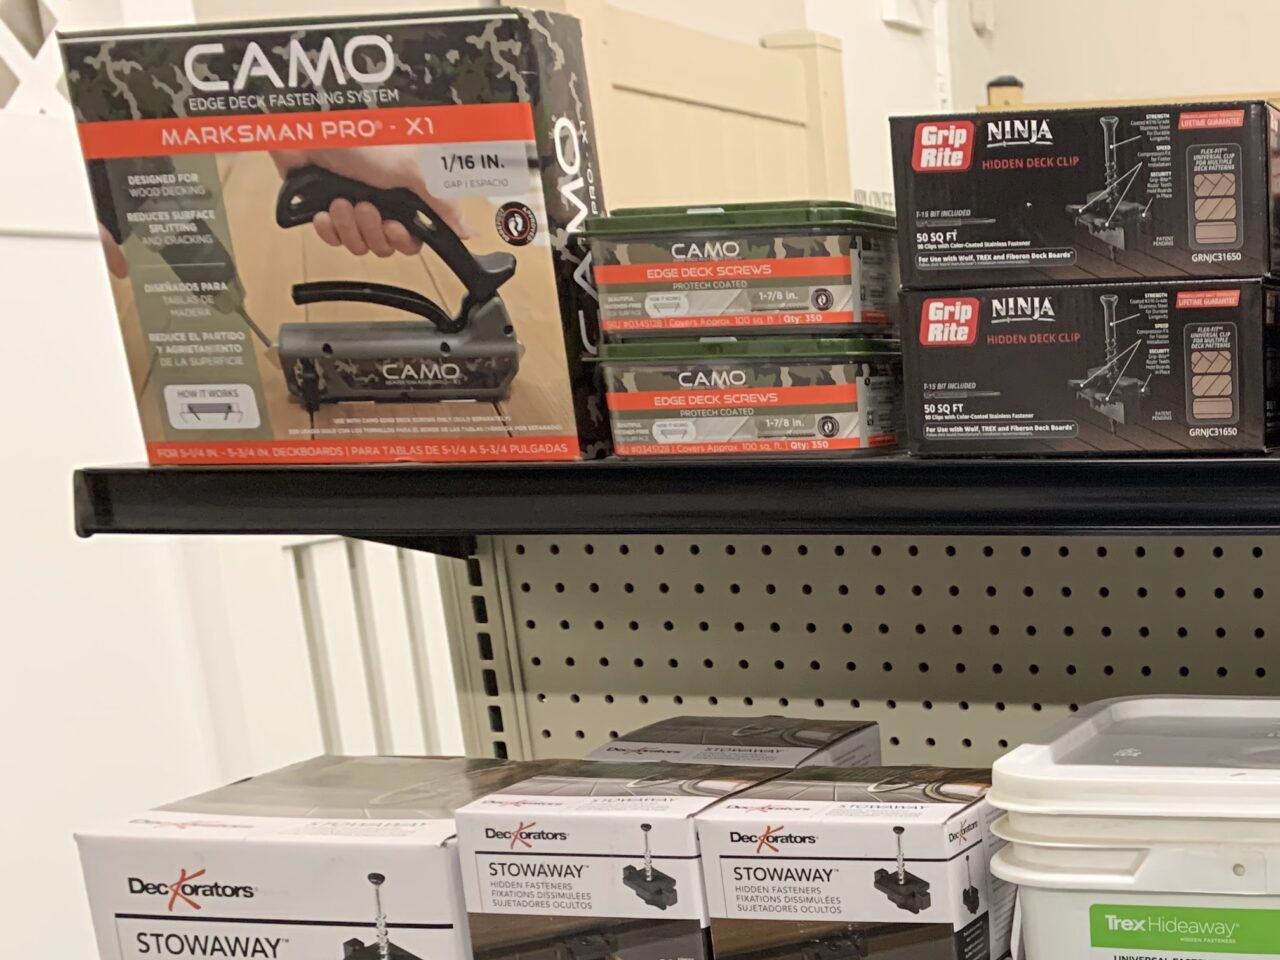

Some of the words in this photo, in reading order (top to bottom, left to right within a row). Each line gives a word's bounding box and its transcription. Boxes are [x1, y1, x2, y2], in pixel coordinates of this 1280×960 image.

[189, 97, 226, 111] EDGE
[229, 95, 265, 109] DECK
[269, 91, 344, 108] FASTENING
[347, 89, 399, 103] SYSTEM
[162, 123, 314, 146] MARKSMAN
[405, 117, 434, 135] X1
[921, 125, 967, 149] Grip
[987, 120, 1053, 142] NINJA
[440, 154, 475, 171] 1/16
[481, 153, 505, 170] IN.
[920, 147, 965, 169] Rite
[982, 158, 1024, 170] HIDDEN
[1027, 157, 1054, 168] DECK
[1056, 155, 1079, 168] CLIP
[128, 175, 175, 185] DESIGNED
[178, 174, 198, 184] FOR
[127, 211, 170, 221] REDUCES
[173, 210, 215, 220] SURFACE
[671, 242, 740, 260] CAMO
[647, 268, 679, 279] EDGE
[681, 267, 714, 278] DECK
[718, 265, 772, 276] SCREWS
[673, 282, 711, 290] PROTECH
[713, 280, 747, 288] COATED
[759, 292, 784, 300] 1-7/8
[787, 290, 798, 300] in.
[784, 314, 802, 324] Qty:
[806, 314, 822, 322] 350
[382, 363, 460, 380] CAMO
[678, 370, 746, 387] CAMO
[924, 403, 936, 413] 50
[938, 403, 950, 415] SQ
[953, 403, 964, 413] FT
[1189, 427, 1237, 437] GRNJC31650
[1105, 915, 1146, 932] Trex
